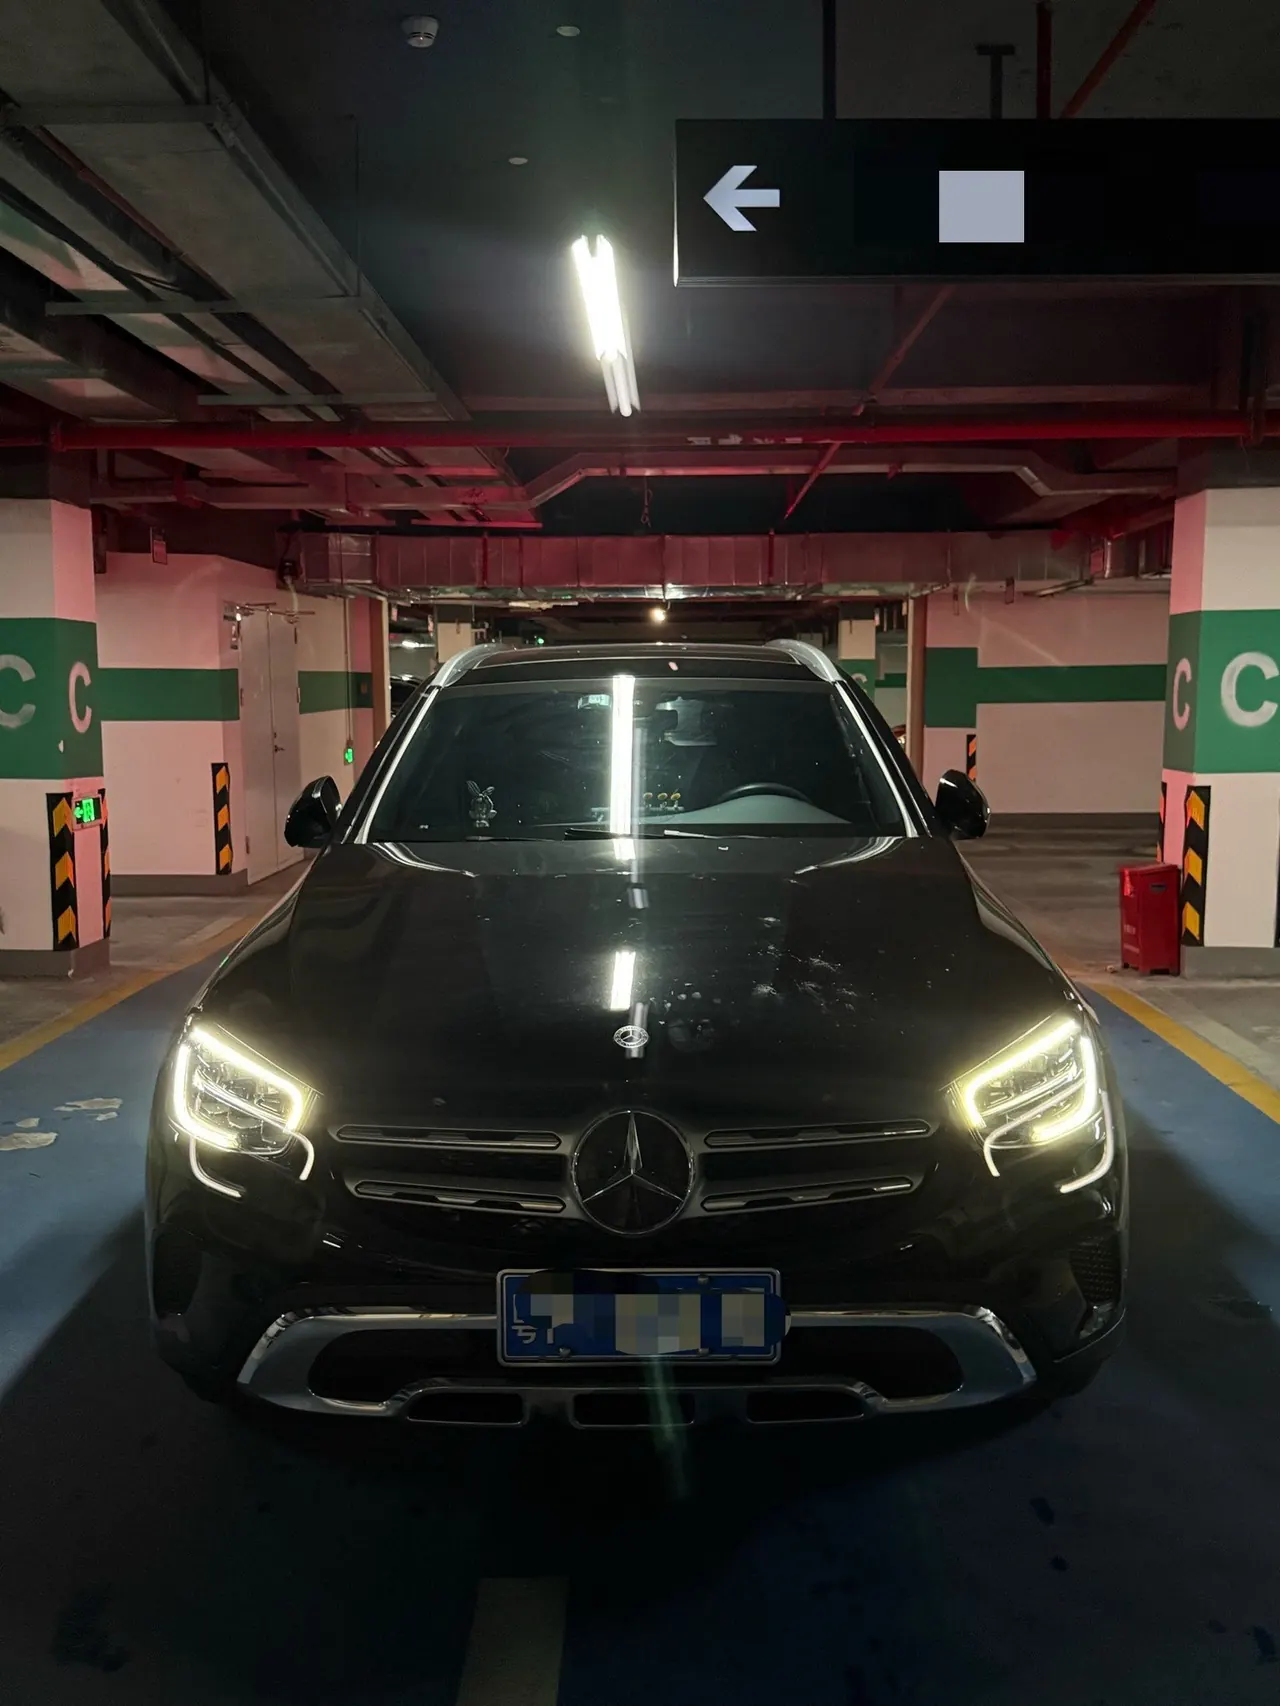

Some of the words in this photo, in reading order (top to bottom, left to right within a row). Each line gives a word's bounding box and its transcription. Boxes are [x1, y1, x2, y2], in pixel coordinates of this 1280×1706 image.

[68, 661, 92, 733] C
[1172, 657, 1192, 731] C
[1220, 651, 1279, 727] C
